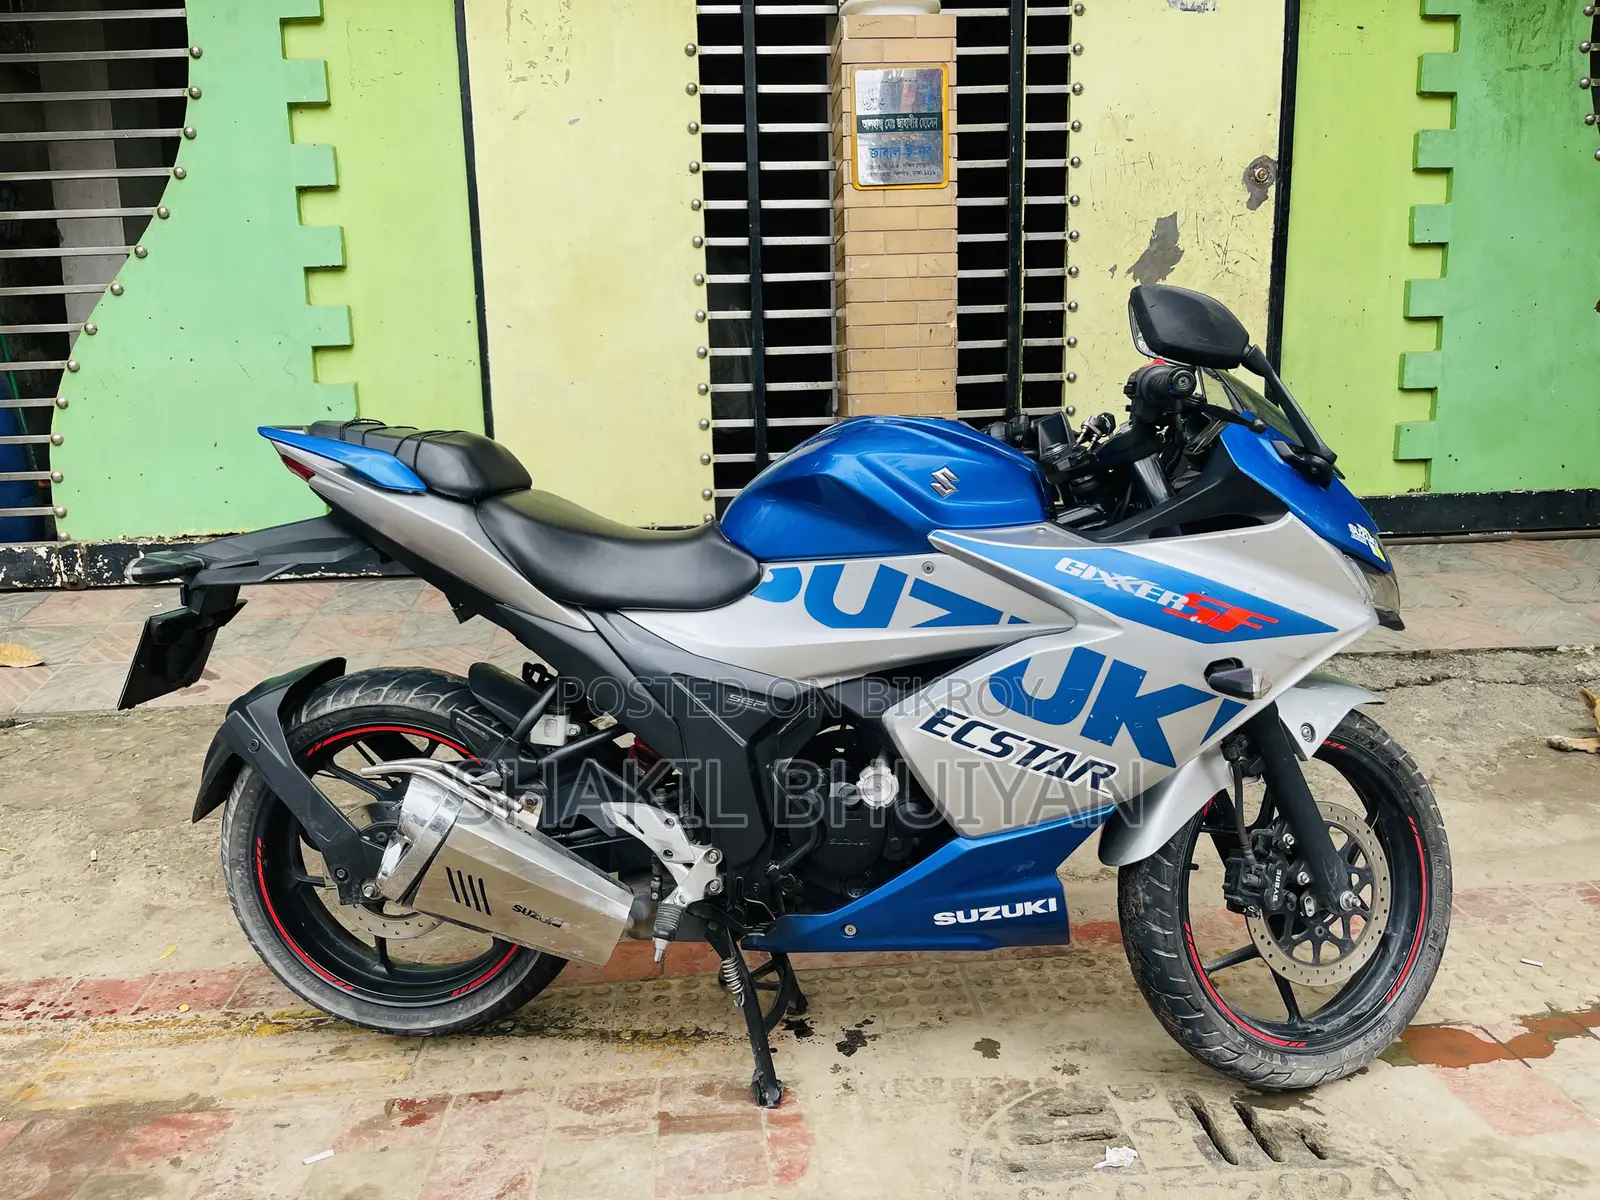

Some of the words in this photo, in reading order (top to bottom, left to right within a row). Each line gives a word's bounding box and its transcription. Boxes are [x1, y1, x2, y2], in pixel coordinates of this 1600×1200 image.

[1055, 558, 1189, 611] GIXXER
[1163, 592, 1280, 633] SF
[919, 706, 1117, 795] ECSTAR
[934, 898, 1058, 926] SUZUKI
[1272, 869, 1283, 902] BYBRE
